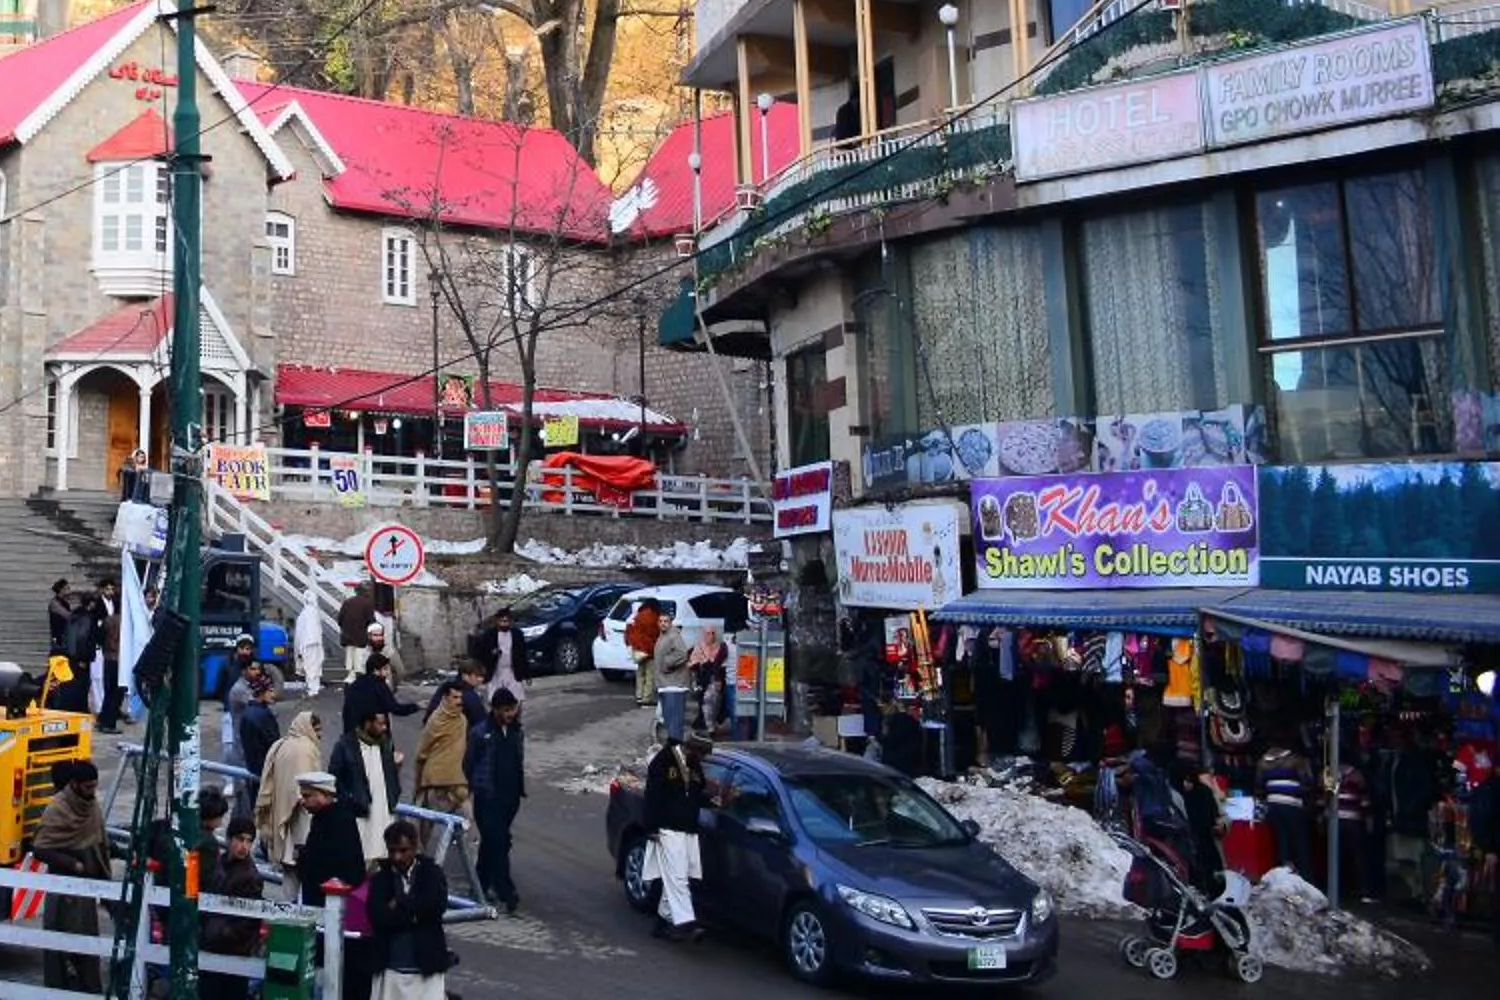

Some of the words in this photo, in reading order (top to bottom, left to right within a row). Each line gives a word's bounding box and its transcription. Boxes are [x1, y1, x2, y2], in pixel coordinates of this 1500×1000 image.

[1219, 56, 1306, 104] FAMILY
[1313, 35, 1416, 85] ROOMS
[1051, 86, 1171, 142] HOTEL
[1220, 105, 1259, 133] GPO
[1264, 89, 1336, 123] CHOWK
[1340, 73, 1424, 111] MURREE
[218, 458, 266, 475] BOOK
[334, 469, 359, 493] 50
[1037, 480, 1173, 536] Khan's
[985, 544, 1086, 578] Shawl's
[1094, 540, 1249, 577] Collection
[1305, 565, 1381, 586] NAYAB
[1389, 567, 1470, 588] SHOES
